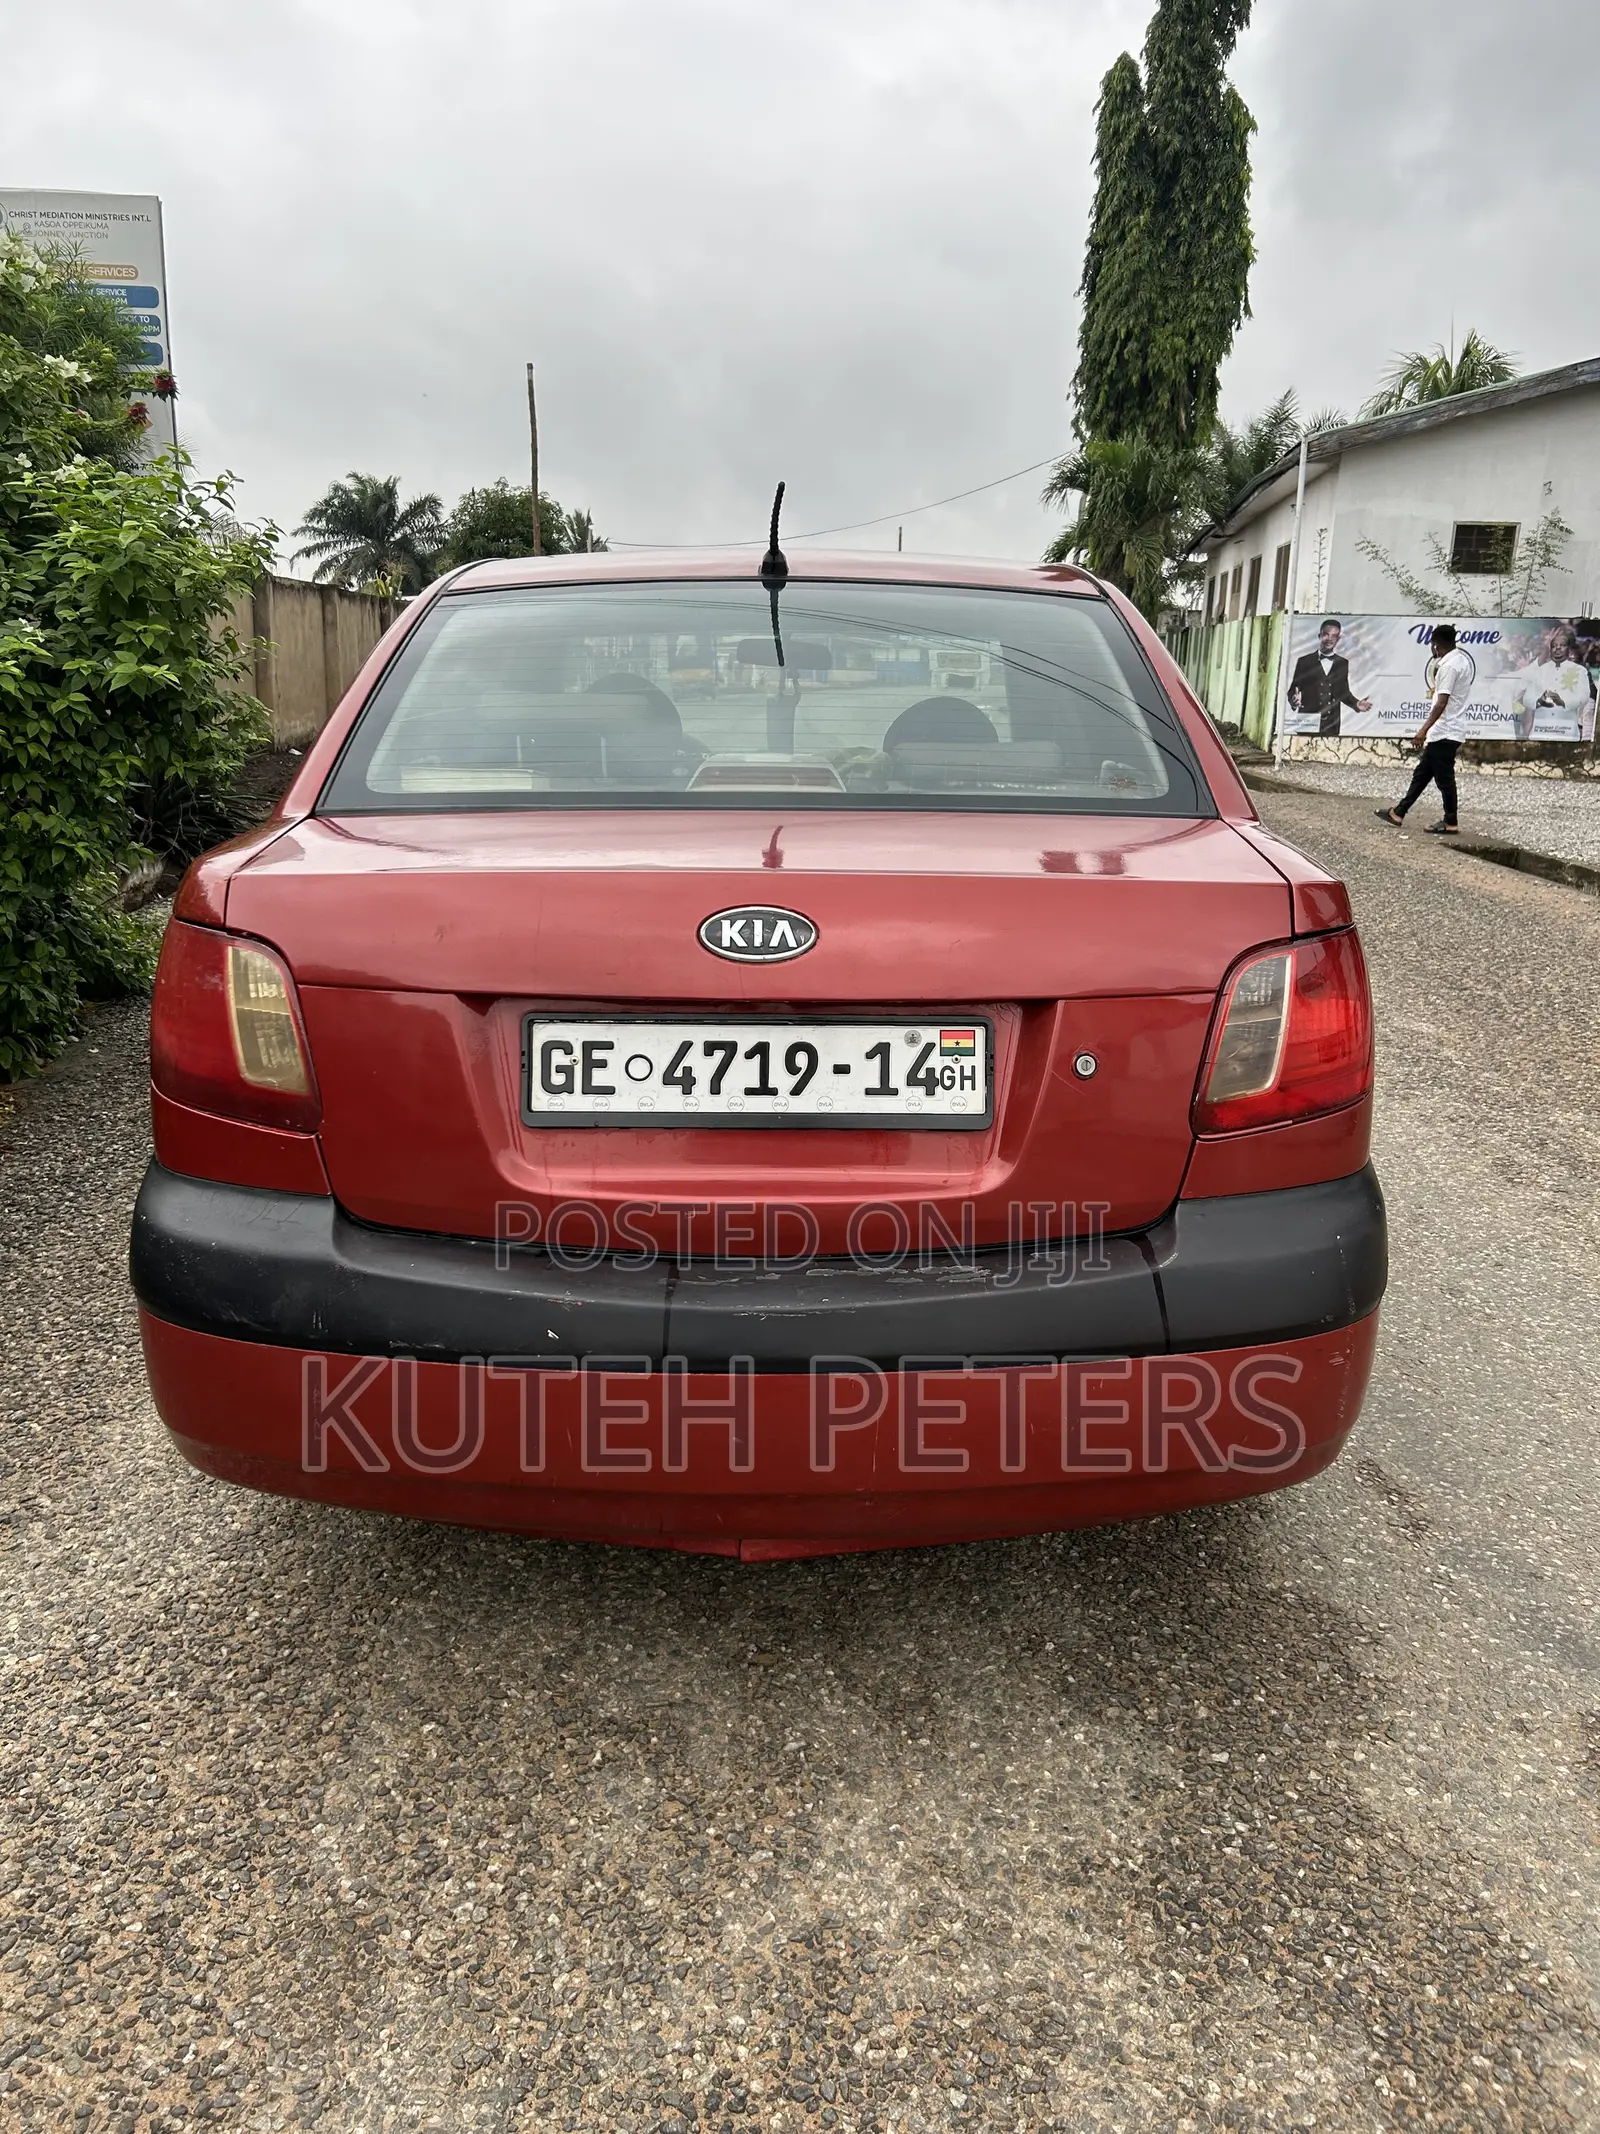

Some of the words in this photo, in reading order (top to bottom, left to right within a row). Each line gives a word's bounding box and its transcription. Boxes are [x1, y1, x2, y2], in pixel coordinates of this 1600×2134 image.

[8, 210, 38, 219] CHRIST
[39, 211, 84, 220] MEDIATION
[85, 212, 131, 221] MINISTRIES
[34, 220, 62, 229] KASOA
[62, 221, 110, 230] OPPEIKUMA
[68, 230, 109, 239] JUNCTION
[87, 267, 136, 277] SERVICES
[139, 315, 150, 323] TO
[1408, 623, 1502, 646] Wcome
[1400, 702, 1431, 712] CHRIS
[1466, 703, 1499, 713] ATION
[1378, 710, 1430, 720] MINISTRIE
[721, 919, 798, 948] KIA
[541, 1040, 616, 1095] GE
[939, 1065, 976, 1091] GH
